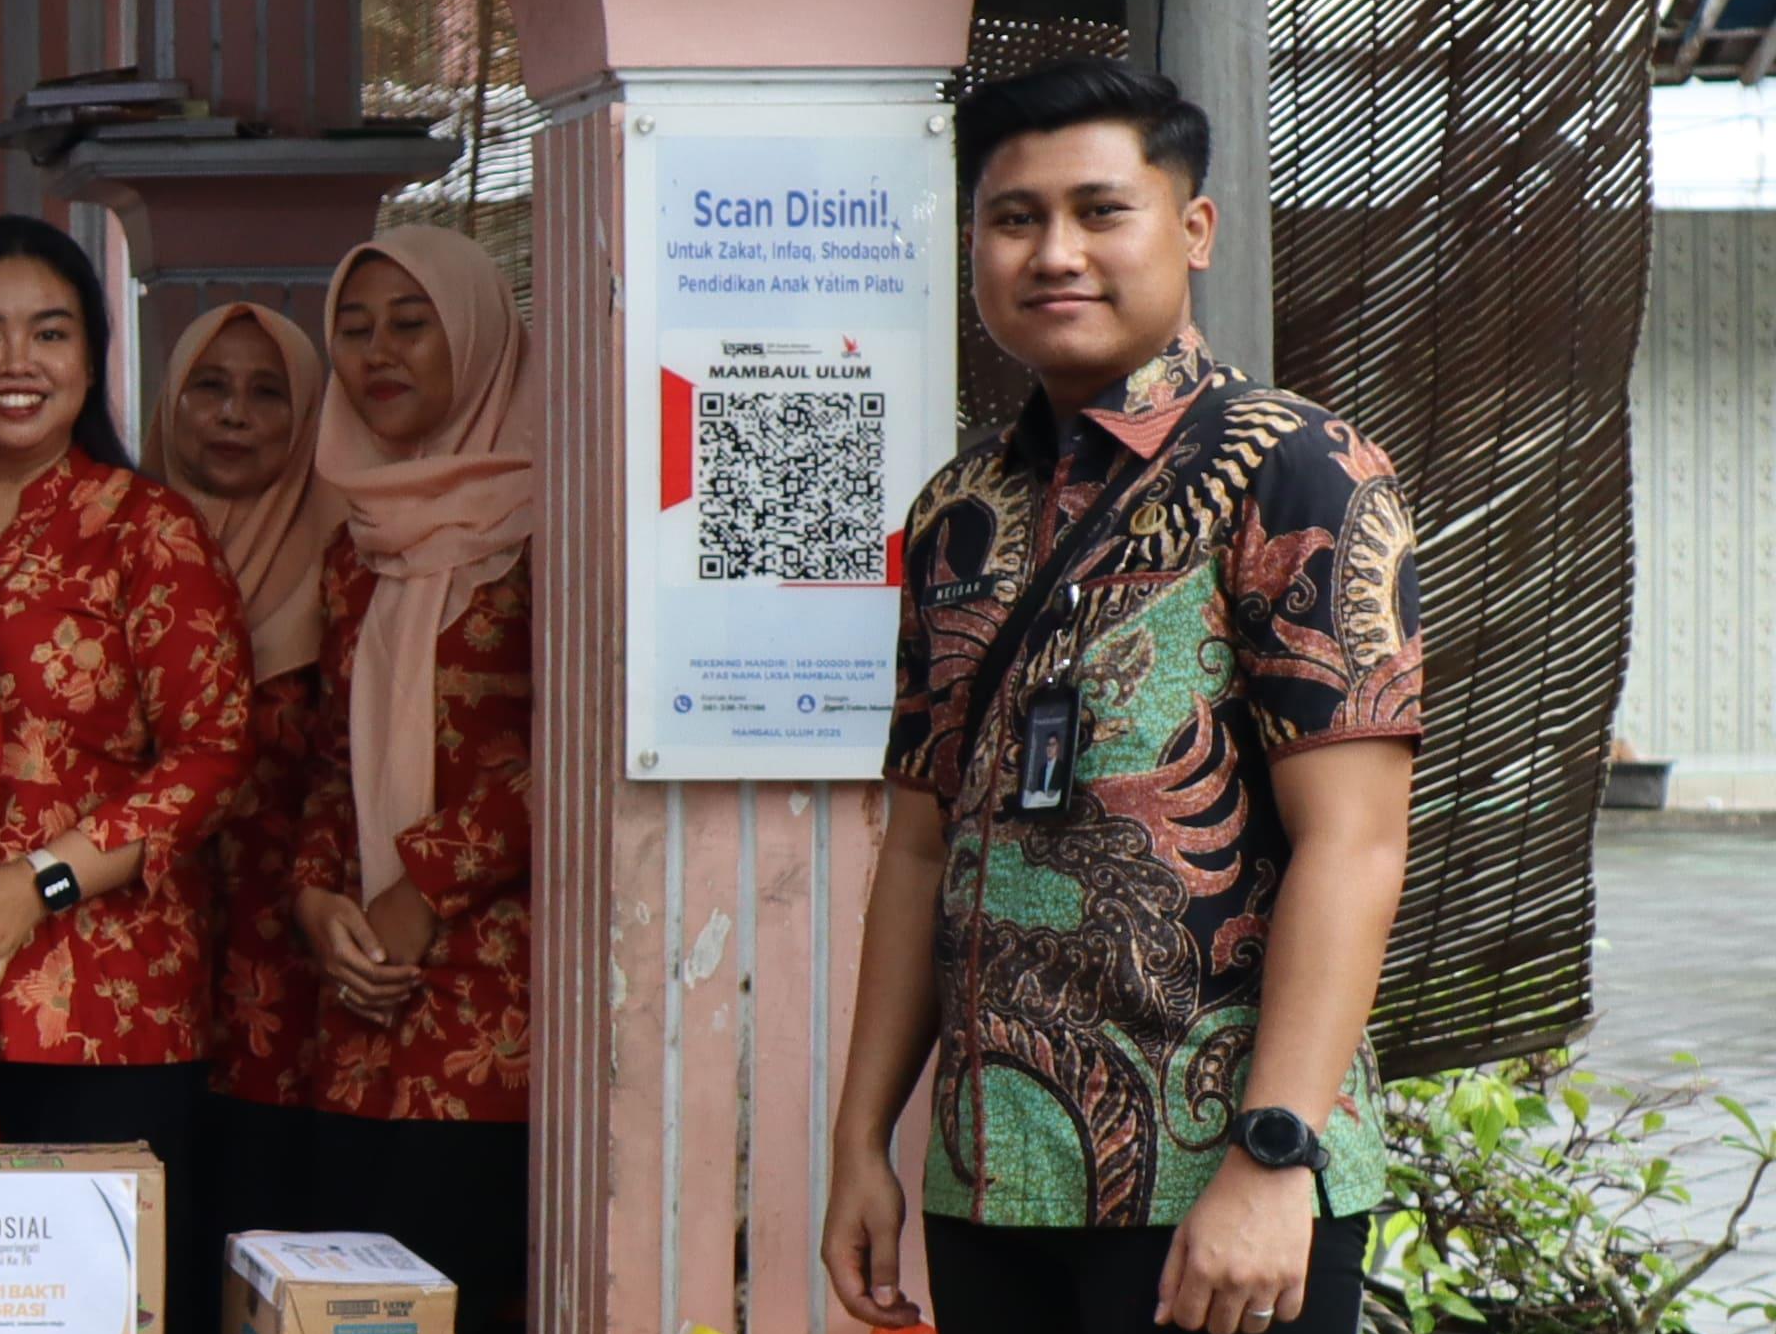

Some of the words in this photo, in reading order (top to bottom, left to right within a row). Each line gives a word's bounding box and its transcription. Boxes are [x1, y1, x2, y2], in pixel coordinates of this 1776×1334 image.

[694, 190, 773, 228] Scan
[786, 189, 889, 228] Disini!
[667, 241, 713, 259] Untuk
[718, 241, 767, 262] Zakat,
[772, 241, 816, 264] Infaq,
[821, 240, 899, 264] Shodaqoh
[905, 242, 915, 259] &
[678, 274, 765, 293] Pendidikan
[770, 274, 809, 293] Anak
[815, 274, 859, 293] Yatim
[864, 274, 904, 293] Piatu
[708, 365, 811, 379] MAMBAUL
[816, 365, 872, 379] ULUM
[793, 671, 842, 681] MAMBAUL
[846, 671, 875, 681] ULUM
[785, 727, 814, 738] ULUM
[9, 1283, 66, 1299] BAKTI
